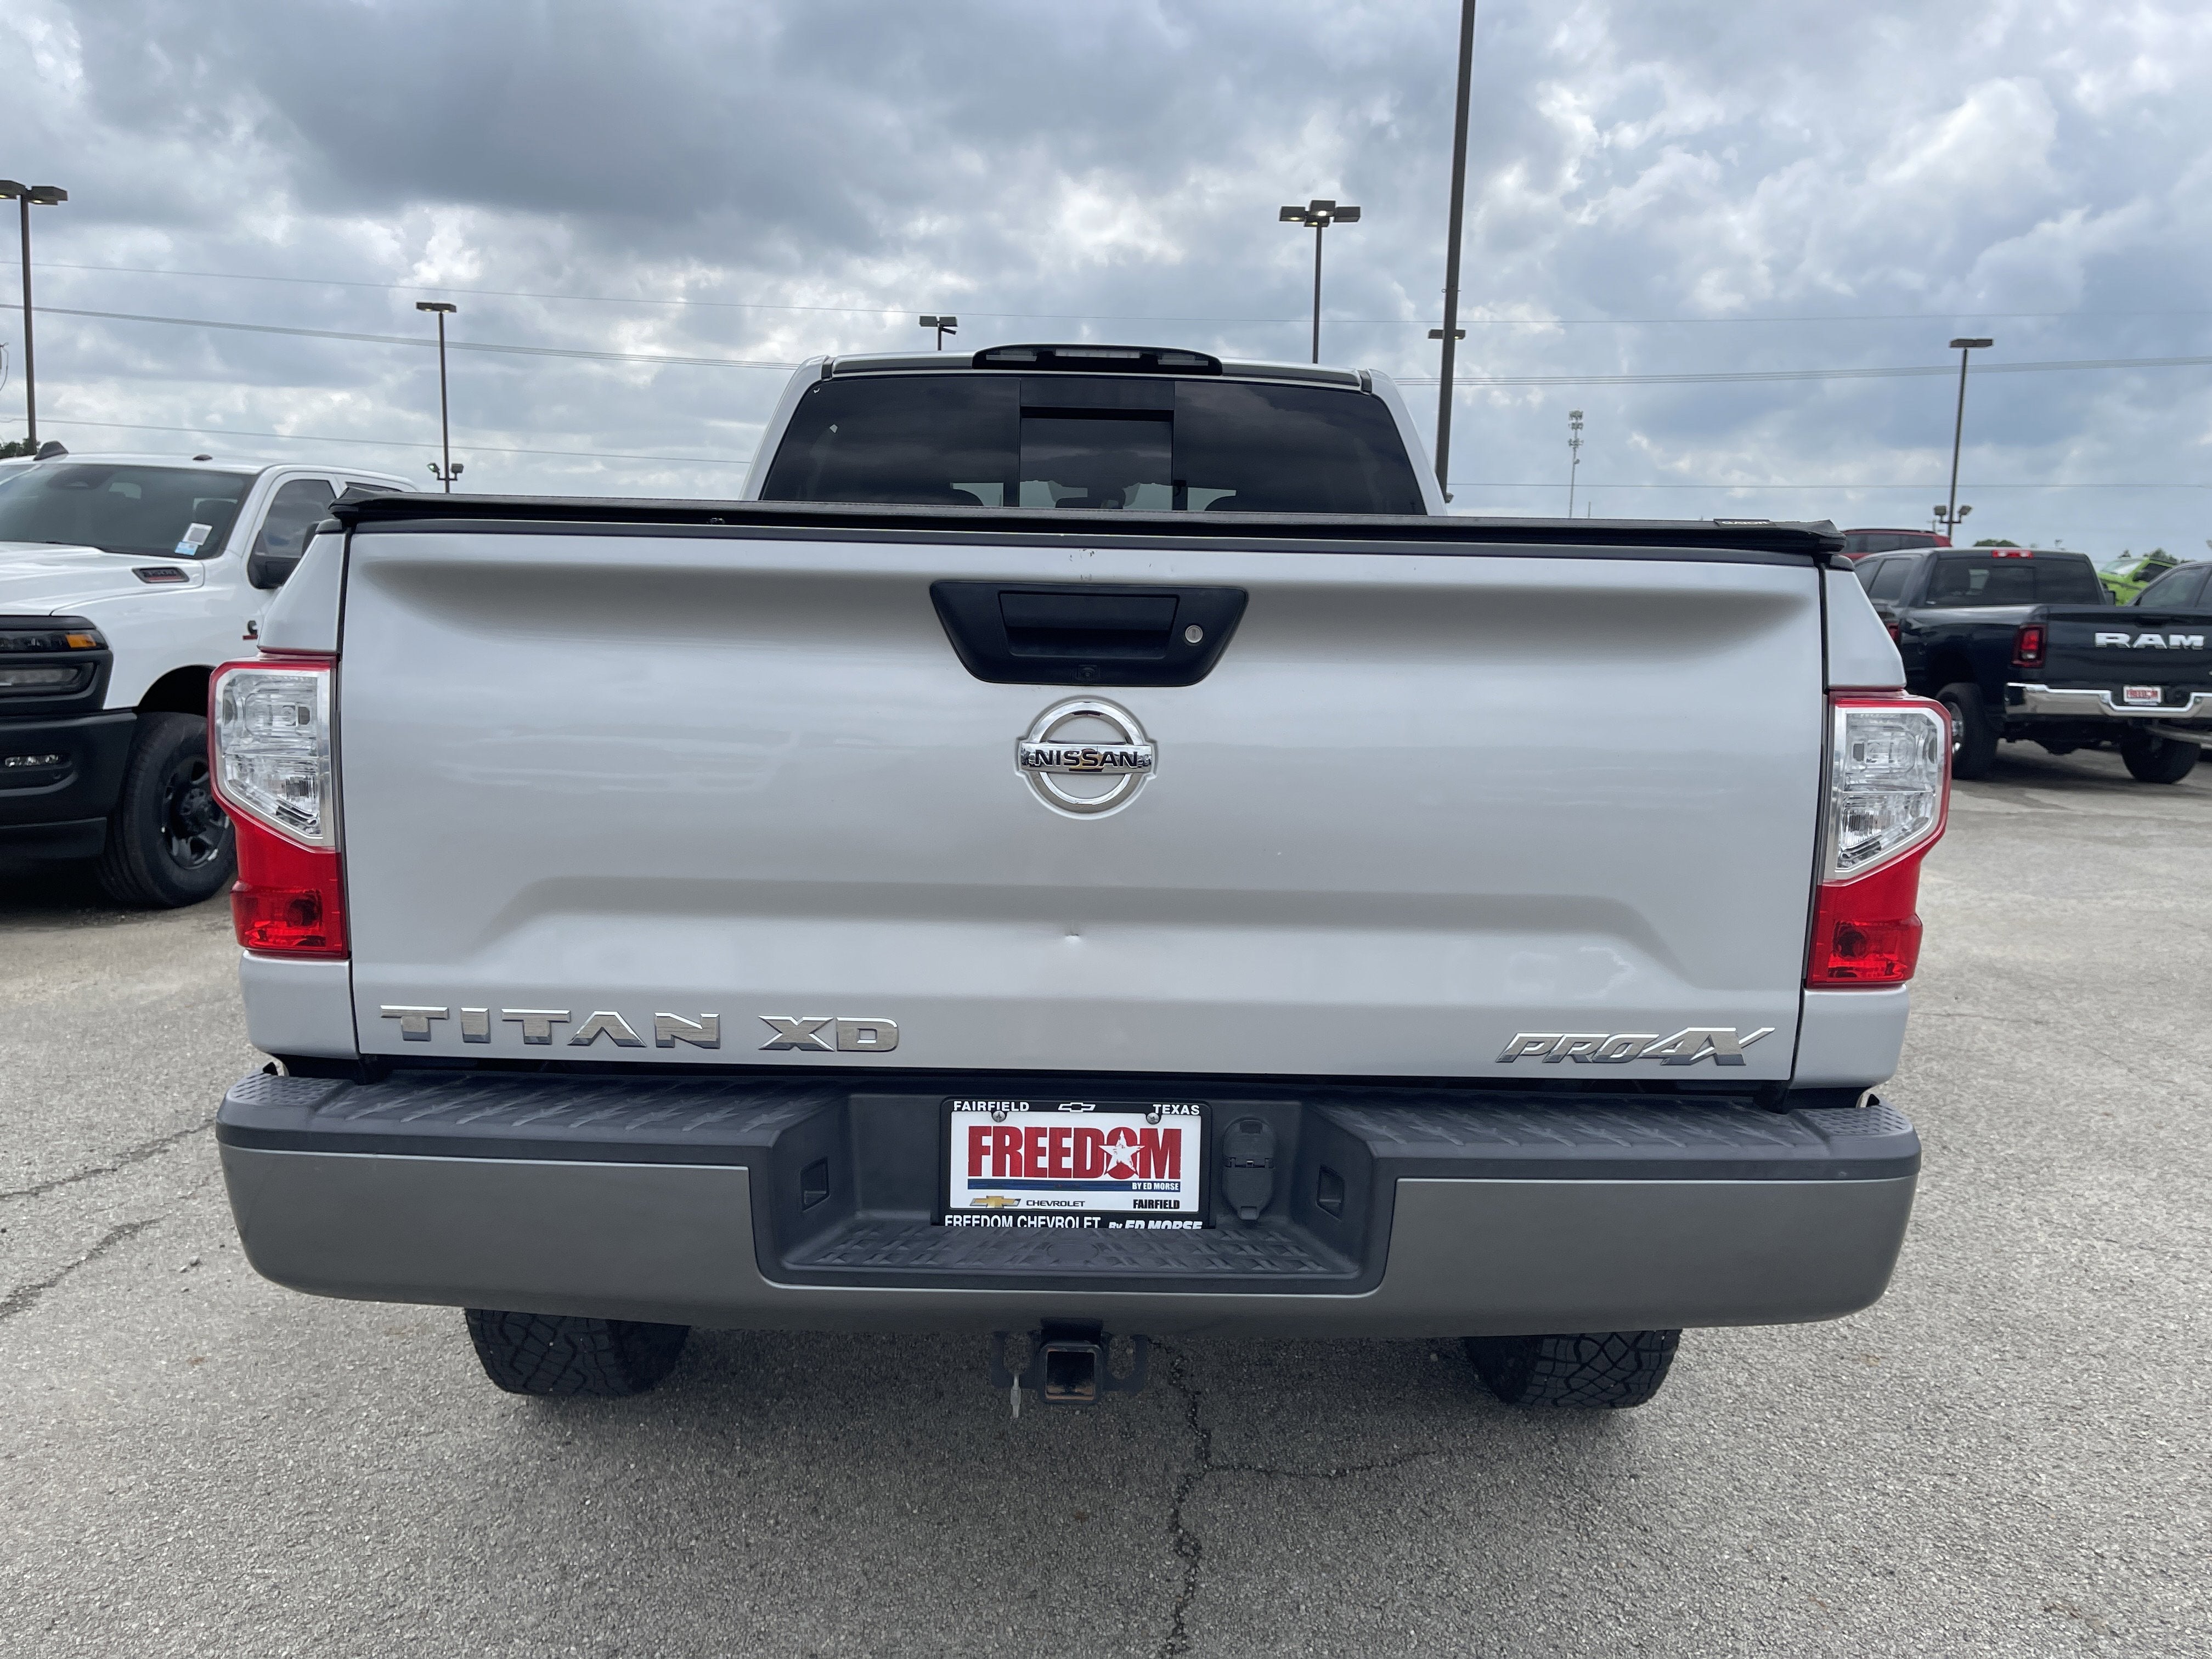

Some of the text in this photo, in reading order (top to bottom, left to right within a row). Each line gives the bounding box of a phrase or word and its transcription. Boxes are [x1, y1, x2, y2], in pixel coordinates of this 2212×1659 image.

[2095, 632, 2204, 650] RAM
[1035, 749, 1138, 768] NISSAN
[380, 1005, 899, 1052] TITAN XD
[953, 1101, 1030, 1112] FAIRFIELD
[1153, 1104, 1200, 1116] TEXAS
[968, 1126, 1182, 1180] FREEDOM
[1153, 1182, 1179, 1190] MORSE
[1133, 1199, 1180, 1209] FAIRFIELD
[945, 1214, 1013, 1227] FREEDOM
